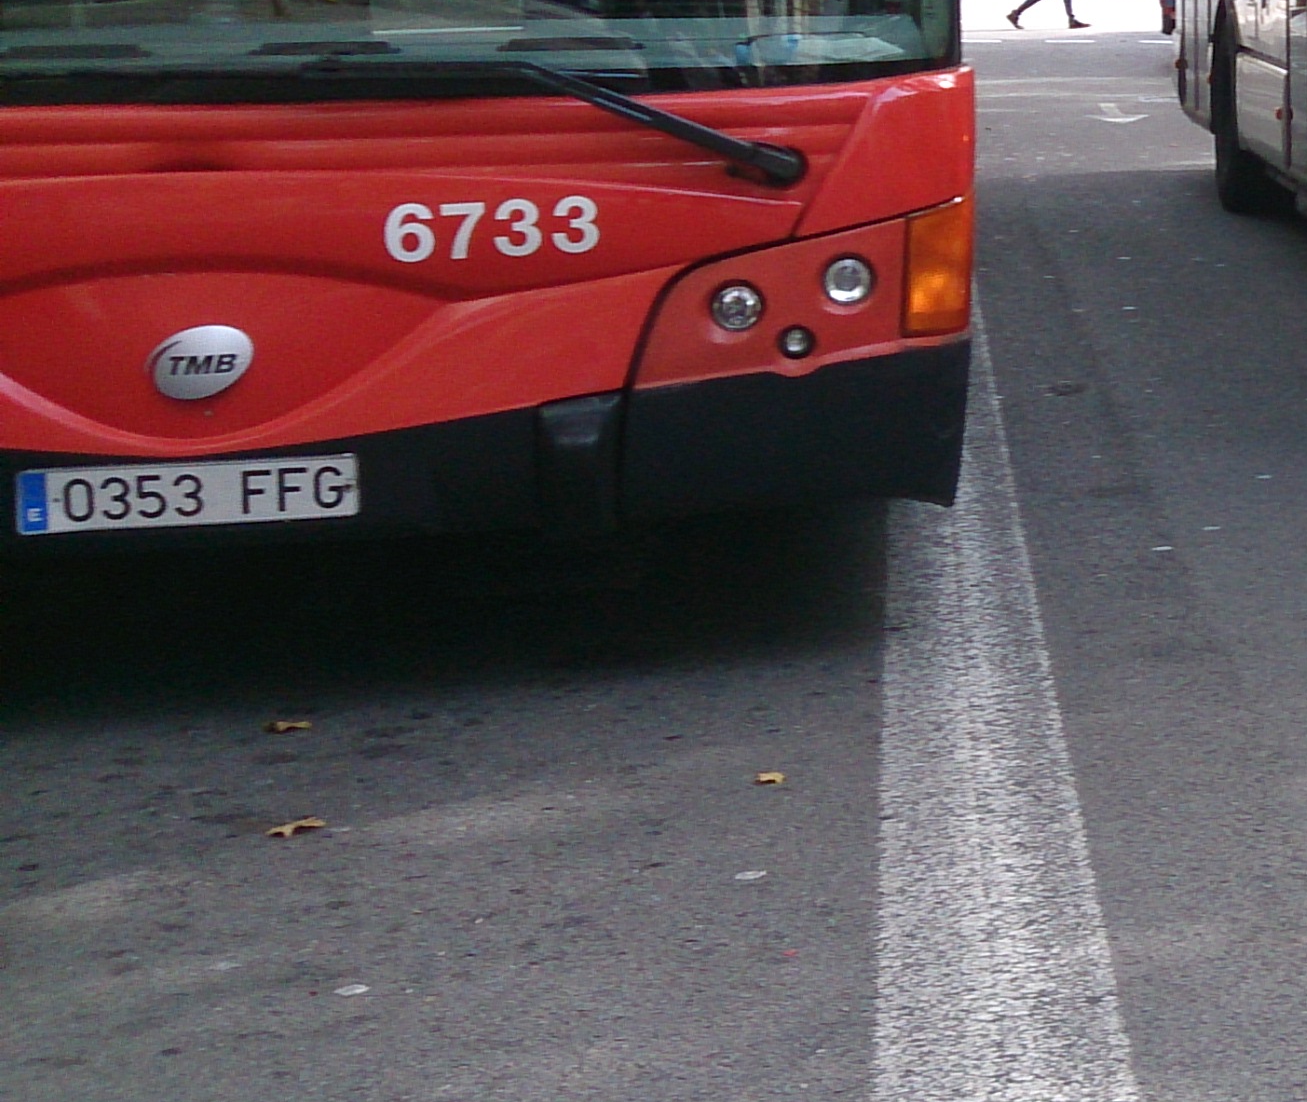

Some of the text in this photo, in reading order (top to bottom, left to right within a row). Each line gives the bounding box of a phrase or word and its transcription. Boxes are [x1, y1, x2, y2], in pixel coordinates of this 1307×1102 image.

[383, 195, 601, 263] 6733
[167, 353, 238, 376] TMB
[62, 473, 204, 523] 0353
[241, 465, 345, 515] FFG
